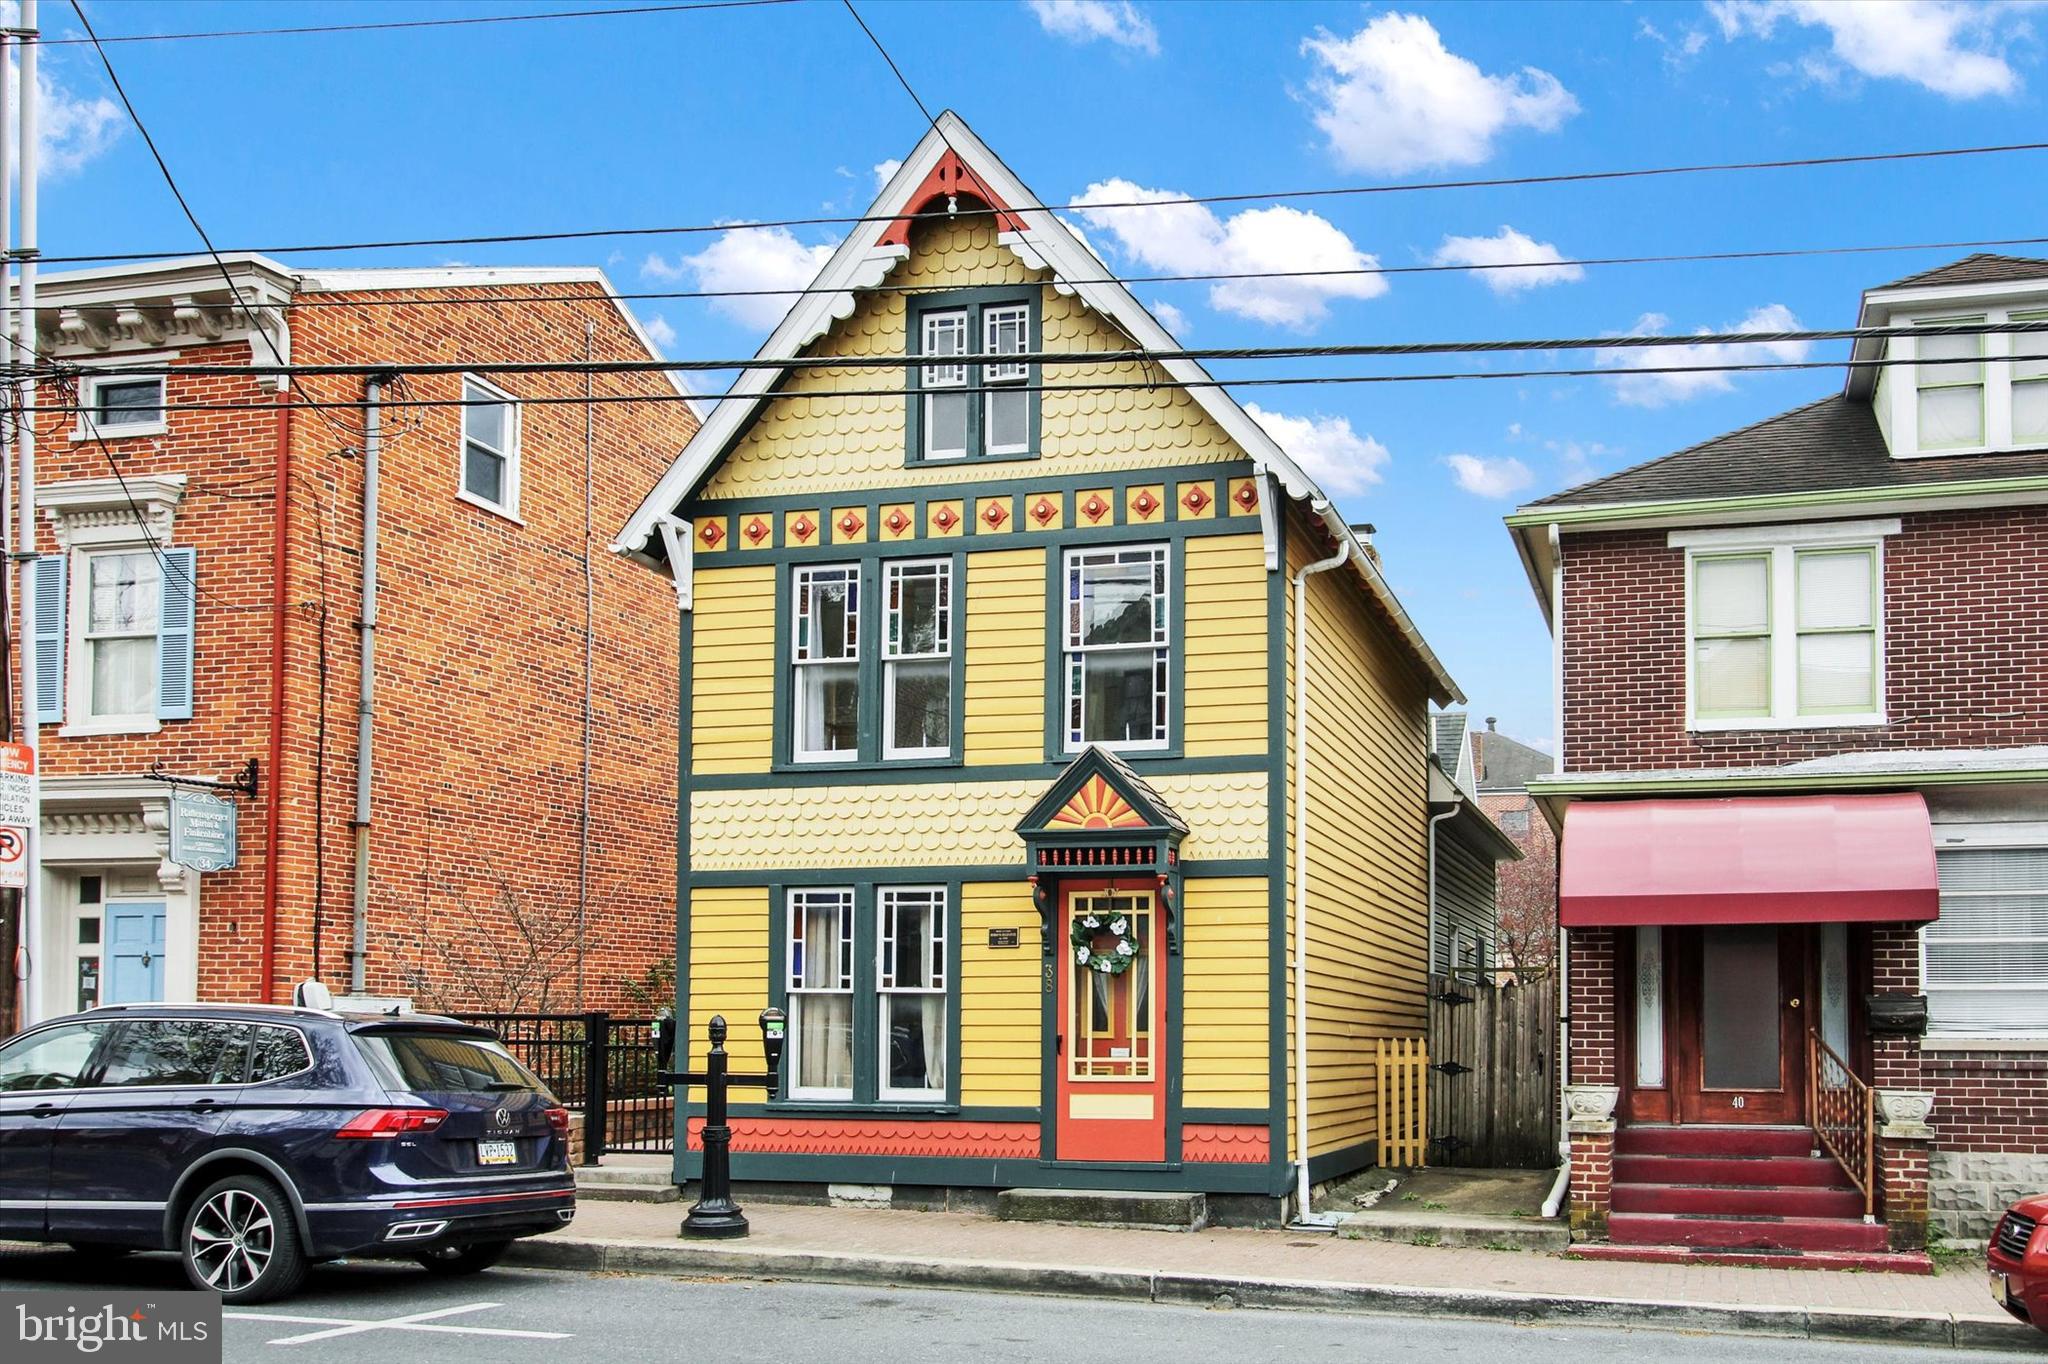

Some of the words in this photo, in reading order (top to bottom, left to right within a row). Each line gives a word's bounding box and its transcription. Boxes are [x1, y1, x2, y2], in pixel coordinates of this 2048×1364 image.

[0, 793, 30, 803] ULATION
[0, 804, 24, 814] ICLES
[8, 815, 32, 824] AWAY
[199, 858, 211, 869] 34
[1732, 1096, 1744, 1108] 40
